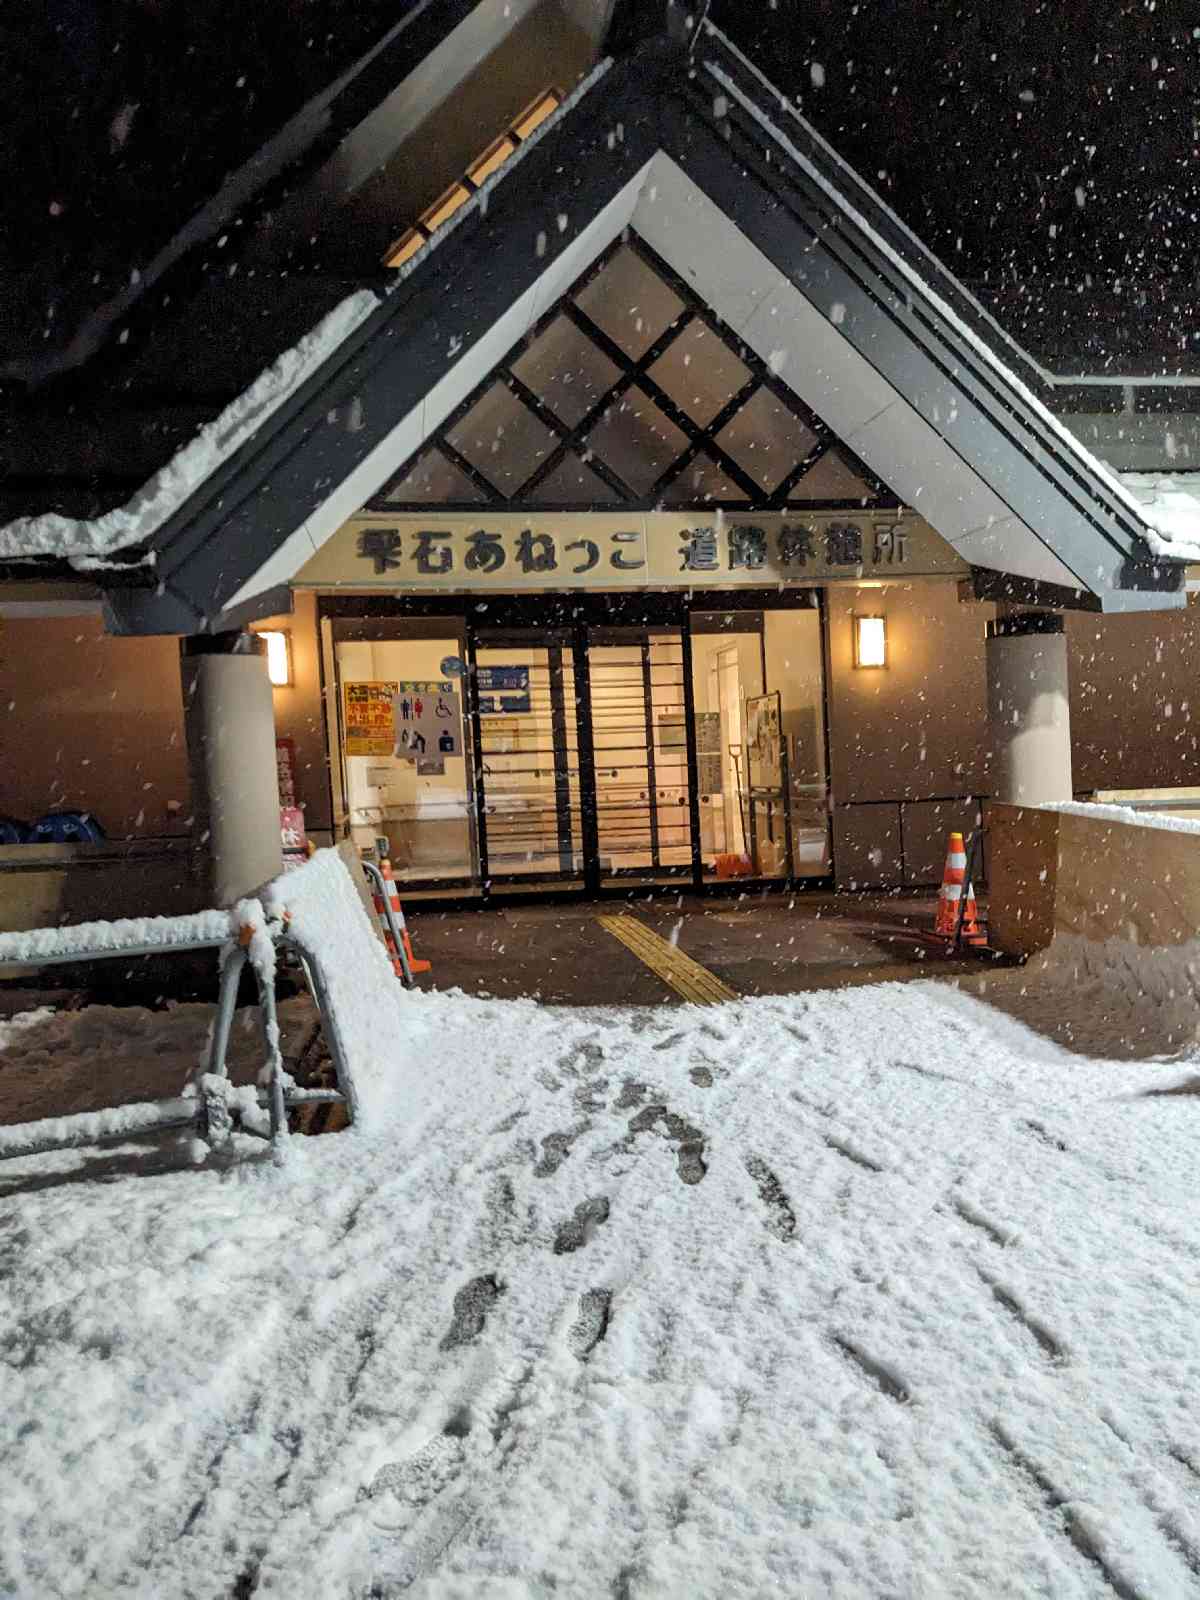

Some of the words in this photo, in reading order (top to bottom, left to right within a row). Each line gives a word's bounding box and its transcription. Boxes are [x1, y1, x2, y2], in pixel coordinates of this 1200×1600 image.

[357, 529, 646, 575] 雫石あねっこ
[678, 521, 908, 571] 道路休憩所
